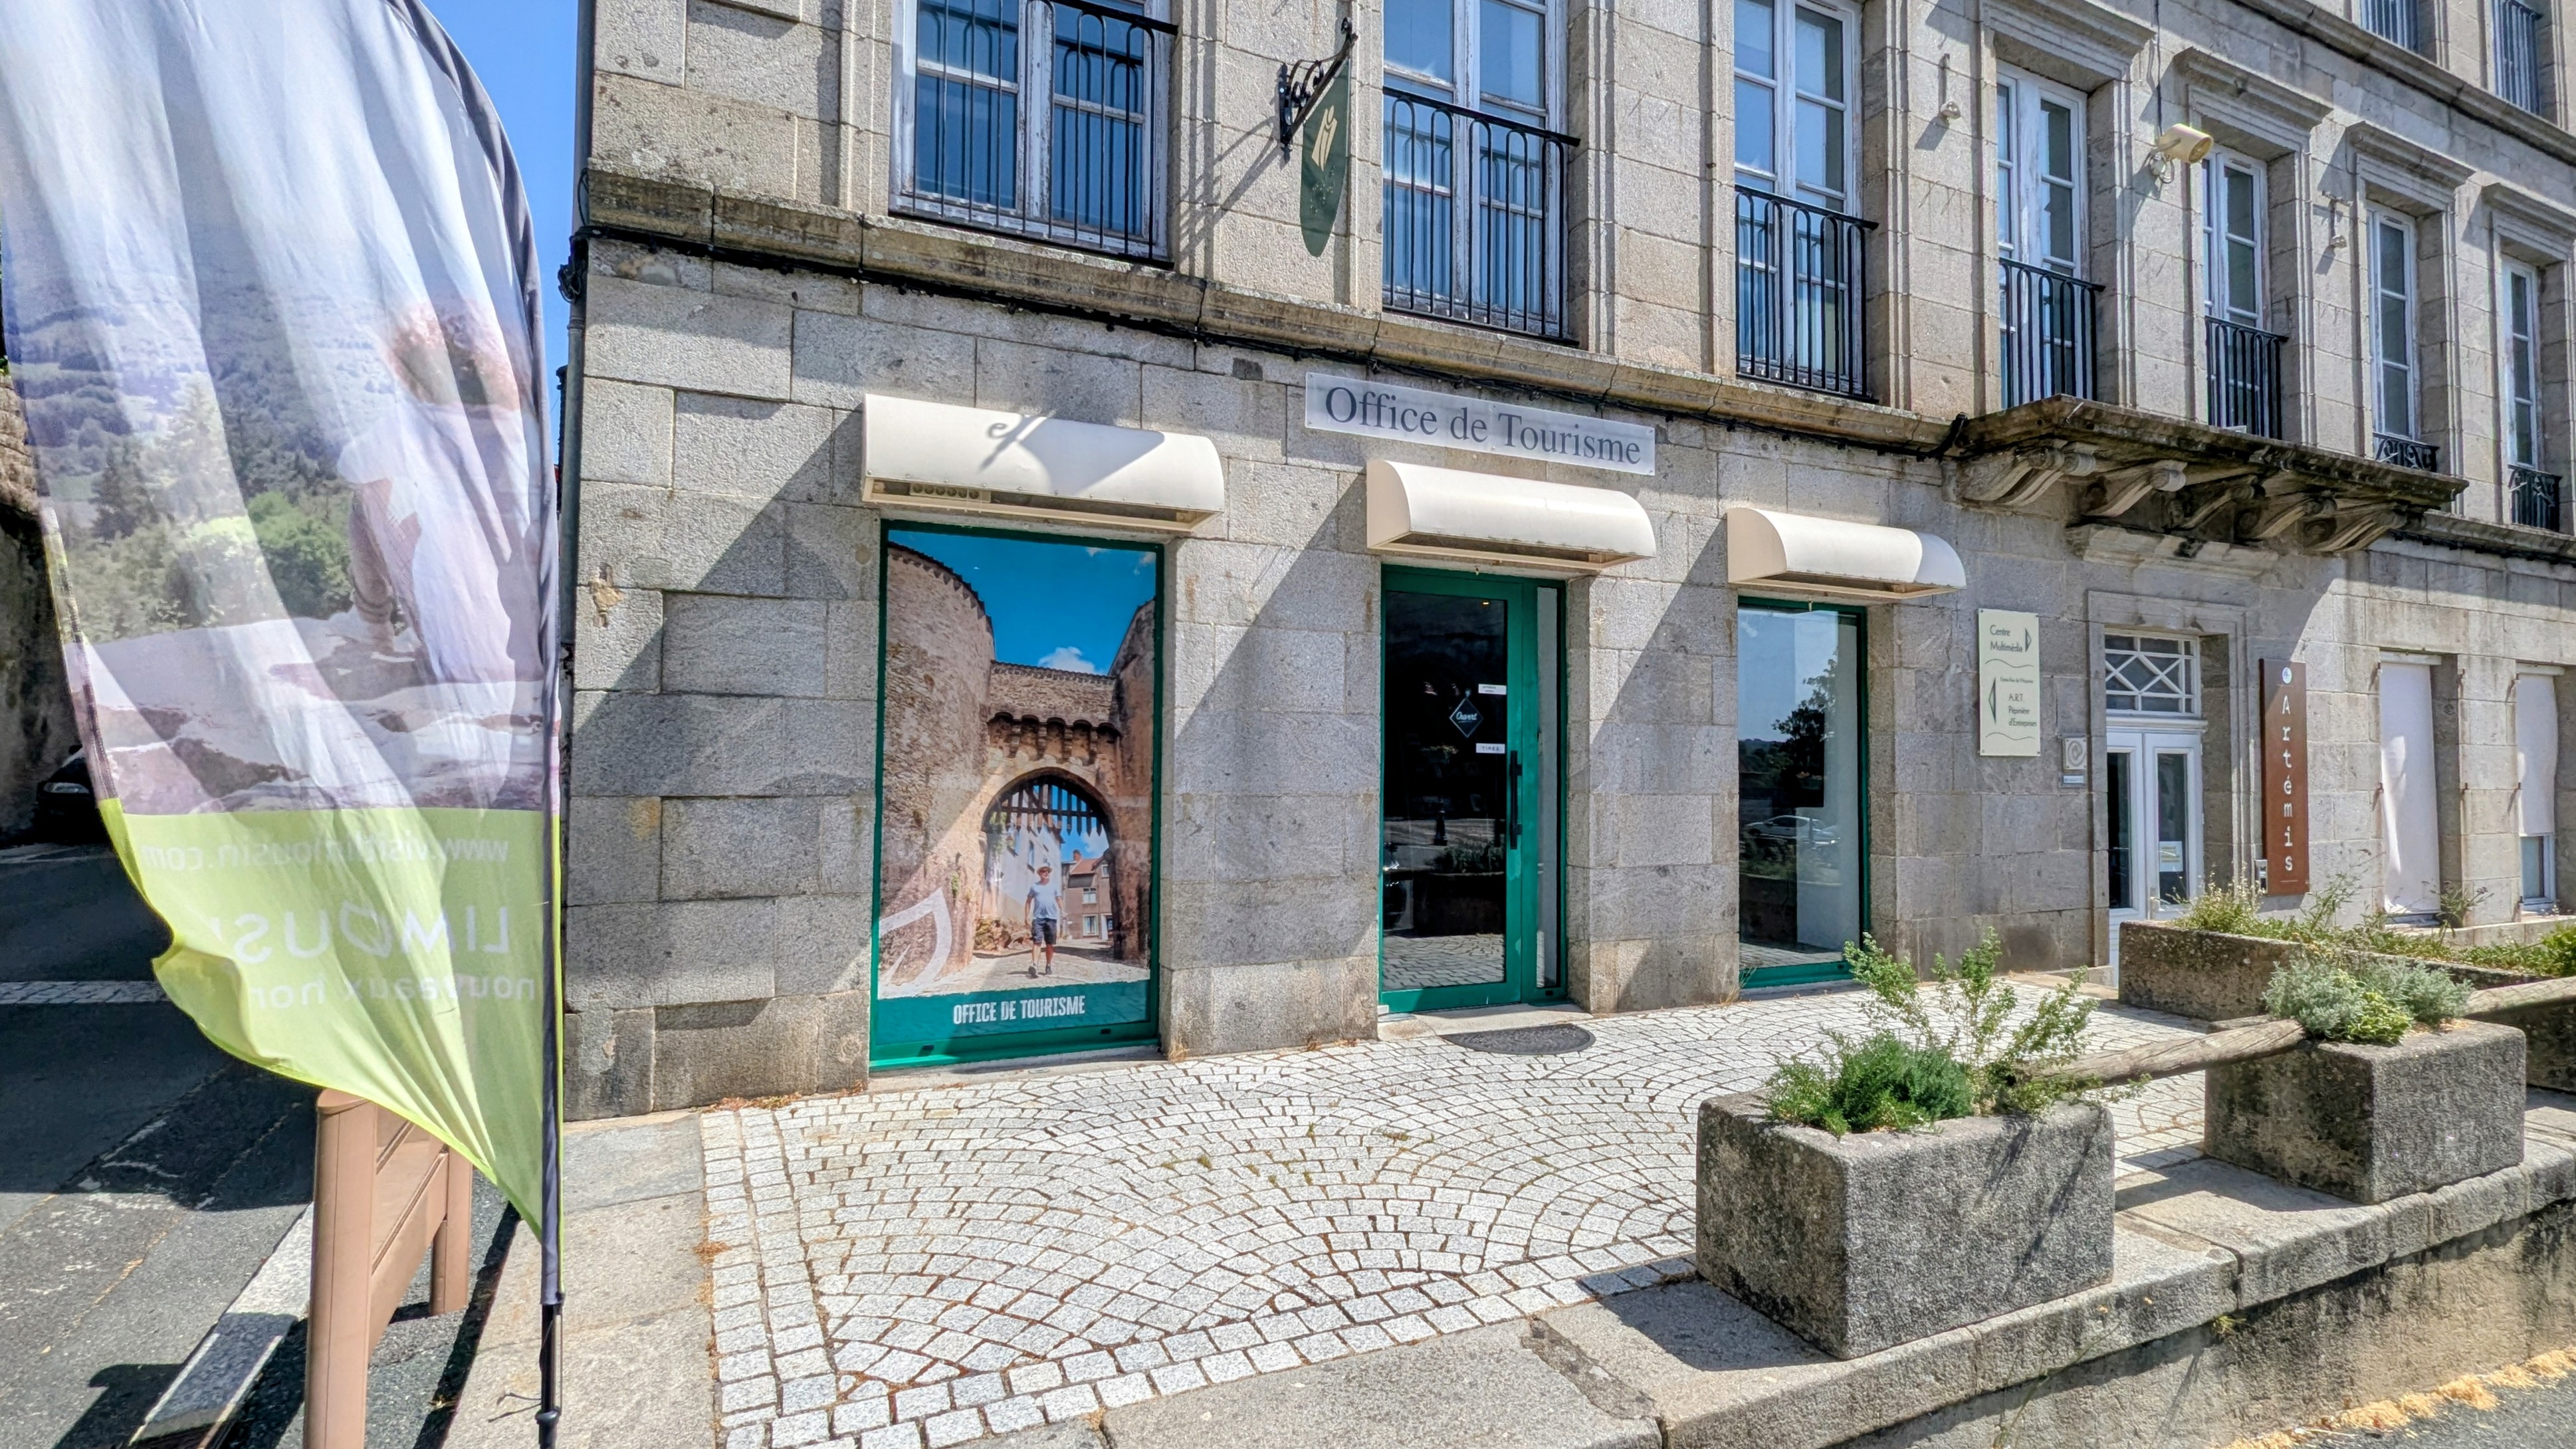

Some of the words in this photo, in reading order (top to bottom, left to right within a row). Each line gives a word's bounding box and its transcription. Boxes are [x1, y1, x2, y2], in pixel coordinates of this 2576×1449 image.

[1325, 386, 1438, 435] Office
[1450, 407, 1488, 443] de
[1498, 412, 1641, 465] Tourisme
[1989, 624, 2011, 636] Centre
[1990, 640, 2023, 653] Multimédia
[1456, 711, 1477, 721] Ouvert
[2282, 695, 2294, 871] Artémis
[953, 1002, 997, 1024] OFFICE
[1000, 1000, 1017, 1021] DE
[1020, 995, 1086, 1019] TOURISME
